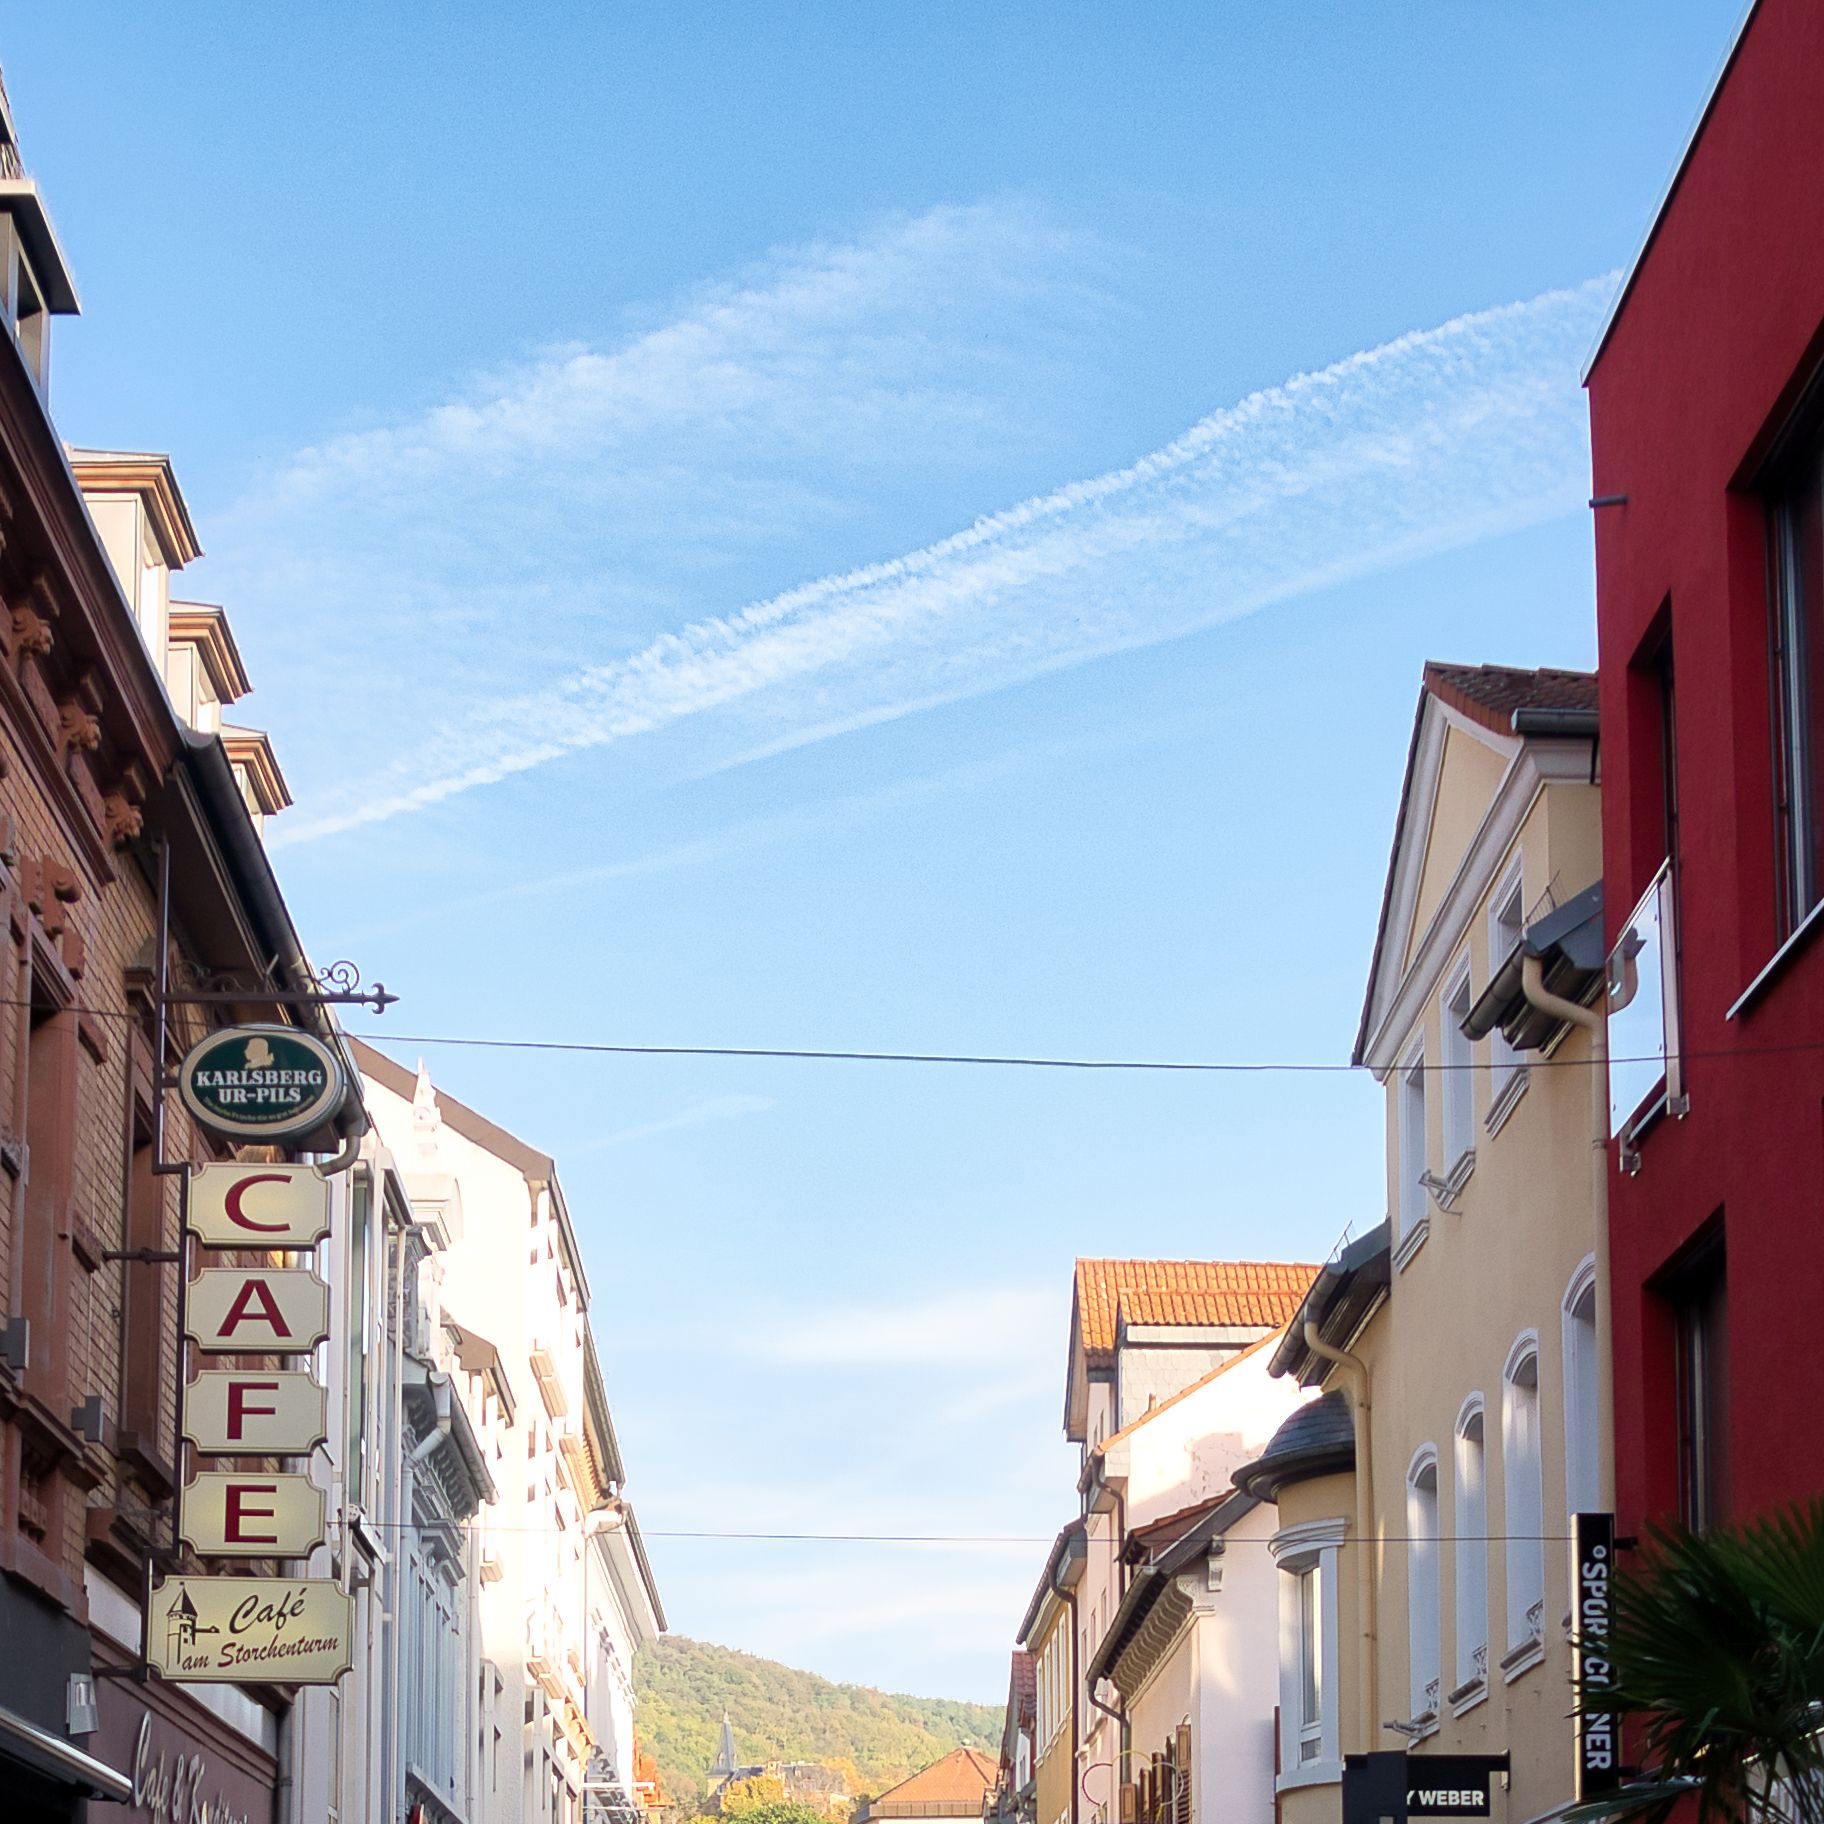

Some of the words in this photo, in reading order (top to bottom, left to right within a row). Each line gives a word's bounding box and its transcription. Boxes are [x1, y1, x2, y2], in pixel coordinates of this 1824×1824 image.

[196, 1069, 323, 1087] KARLSBERG
[218, 1087, 302, 1104] UR-PILS
[229, 1586, 308, 1636] Café
[181, 1653, 210, 1671] am
[217, 1632, 340, 1669] Storchenturm
[1584, 1657, 1613, 1770] CNER
[1417, 1789, 1485, 1806] WEBER
